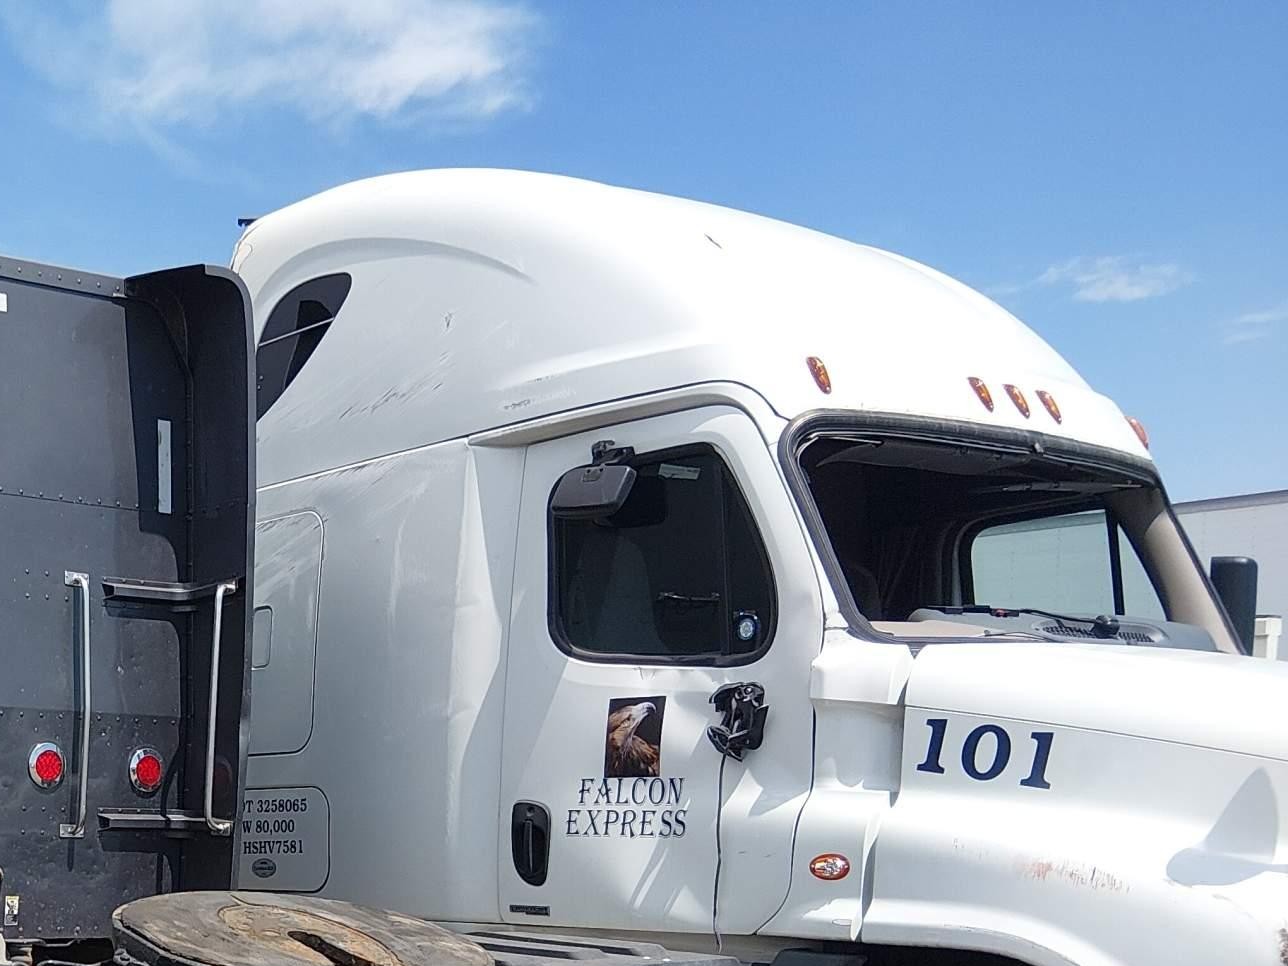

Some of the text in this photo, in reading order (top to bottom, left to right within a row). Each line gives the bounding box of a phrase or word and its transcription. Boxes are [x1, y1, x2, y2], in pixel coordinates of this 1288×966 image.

[917, 718, 1054, 789] 101
[579, 777, 685, 806] FALCON
[257, 798, 307, 813] 3258065
[255, 819, 295, 835] 80,000
[566, 809, 688, 838] EXPRESS
[243, 839, 304, 855] HSHV7581
